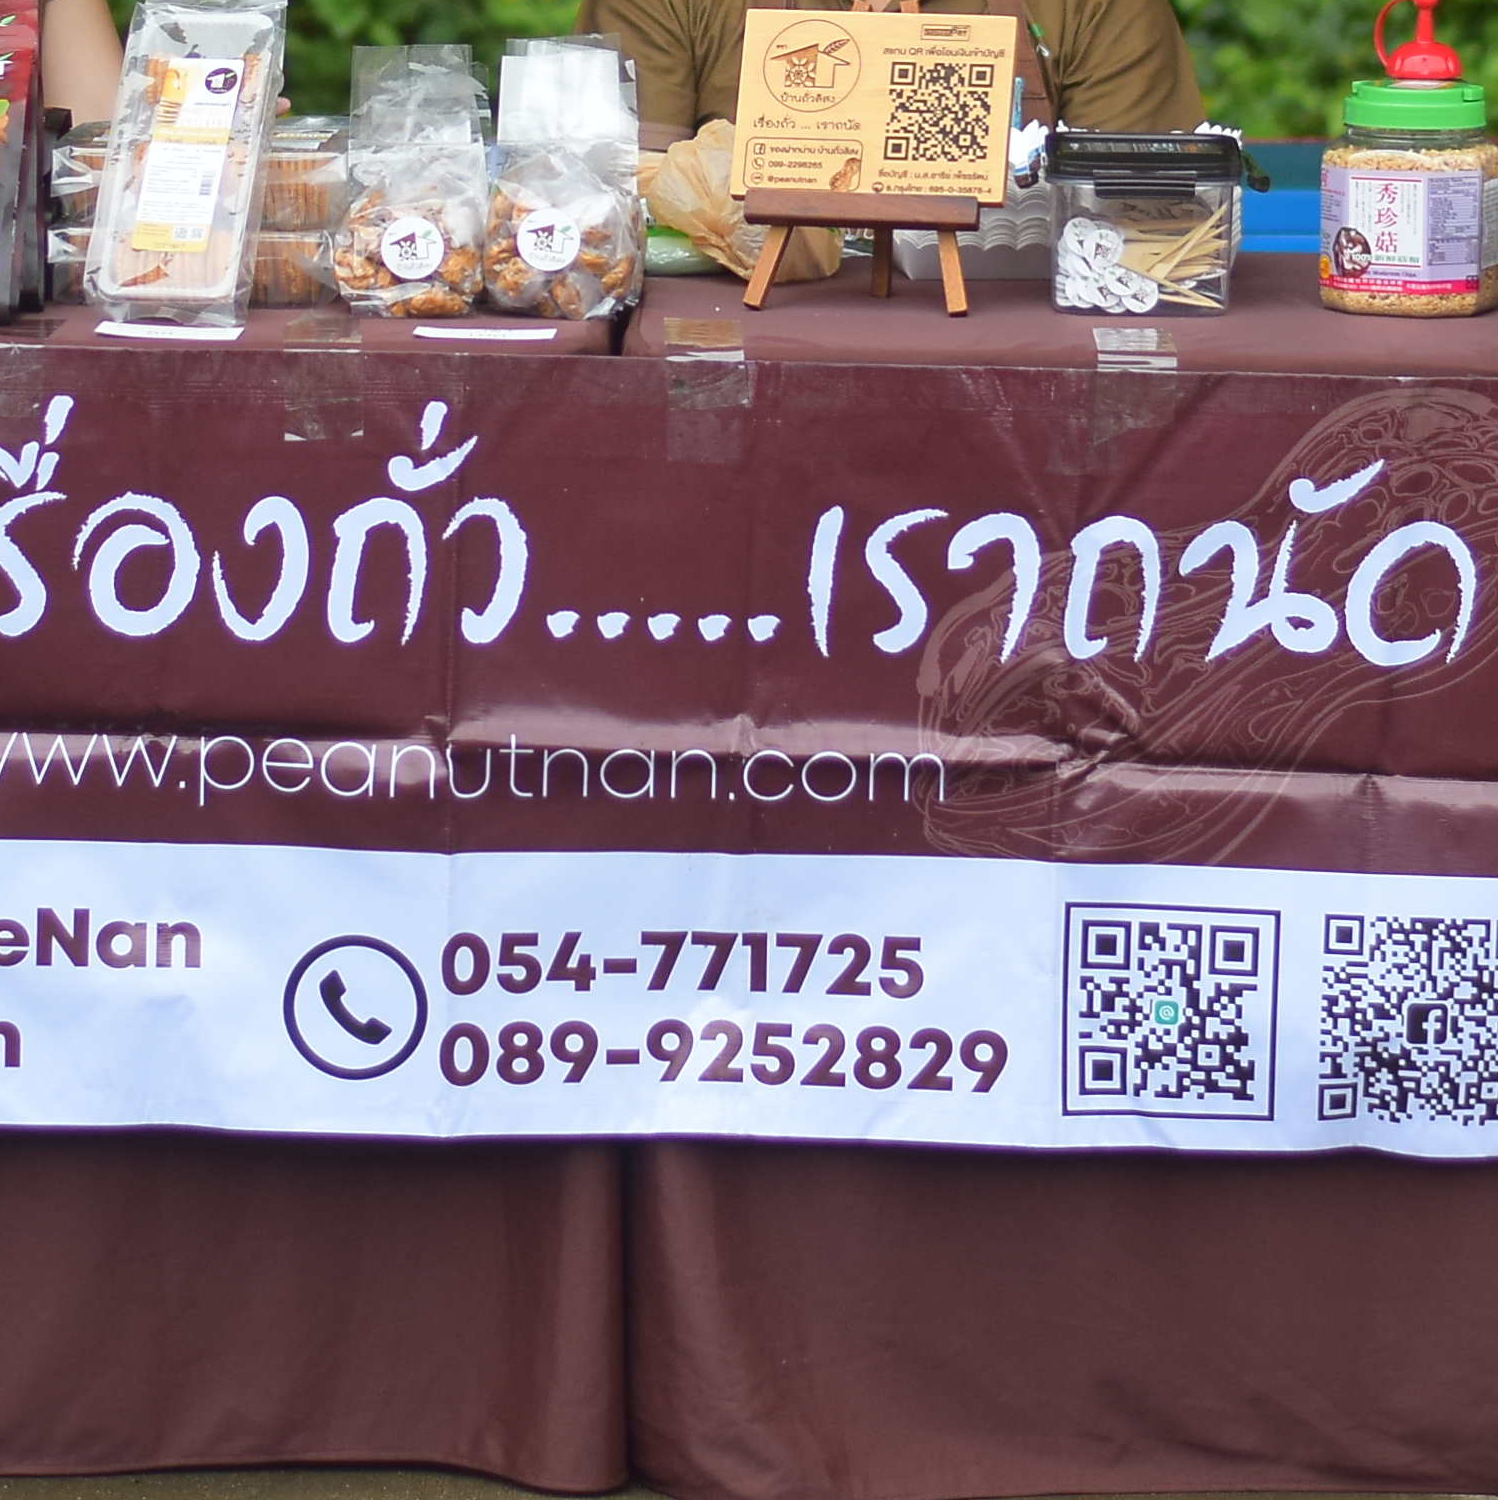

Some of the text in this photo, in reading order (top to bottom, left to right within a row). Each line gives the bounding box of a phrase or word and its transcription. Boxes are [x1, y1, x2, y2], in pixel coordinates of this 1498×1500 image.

[908, 47, 923, 56] QR
[780, 91, 836, 104] บ้านถั่วลิสง
[1374, 182, 1399, 254] 秀珍菇
[440, 930, 925, 999] 054-771725
[439, 1020, 1009, 1093] 089-9252829
